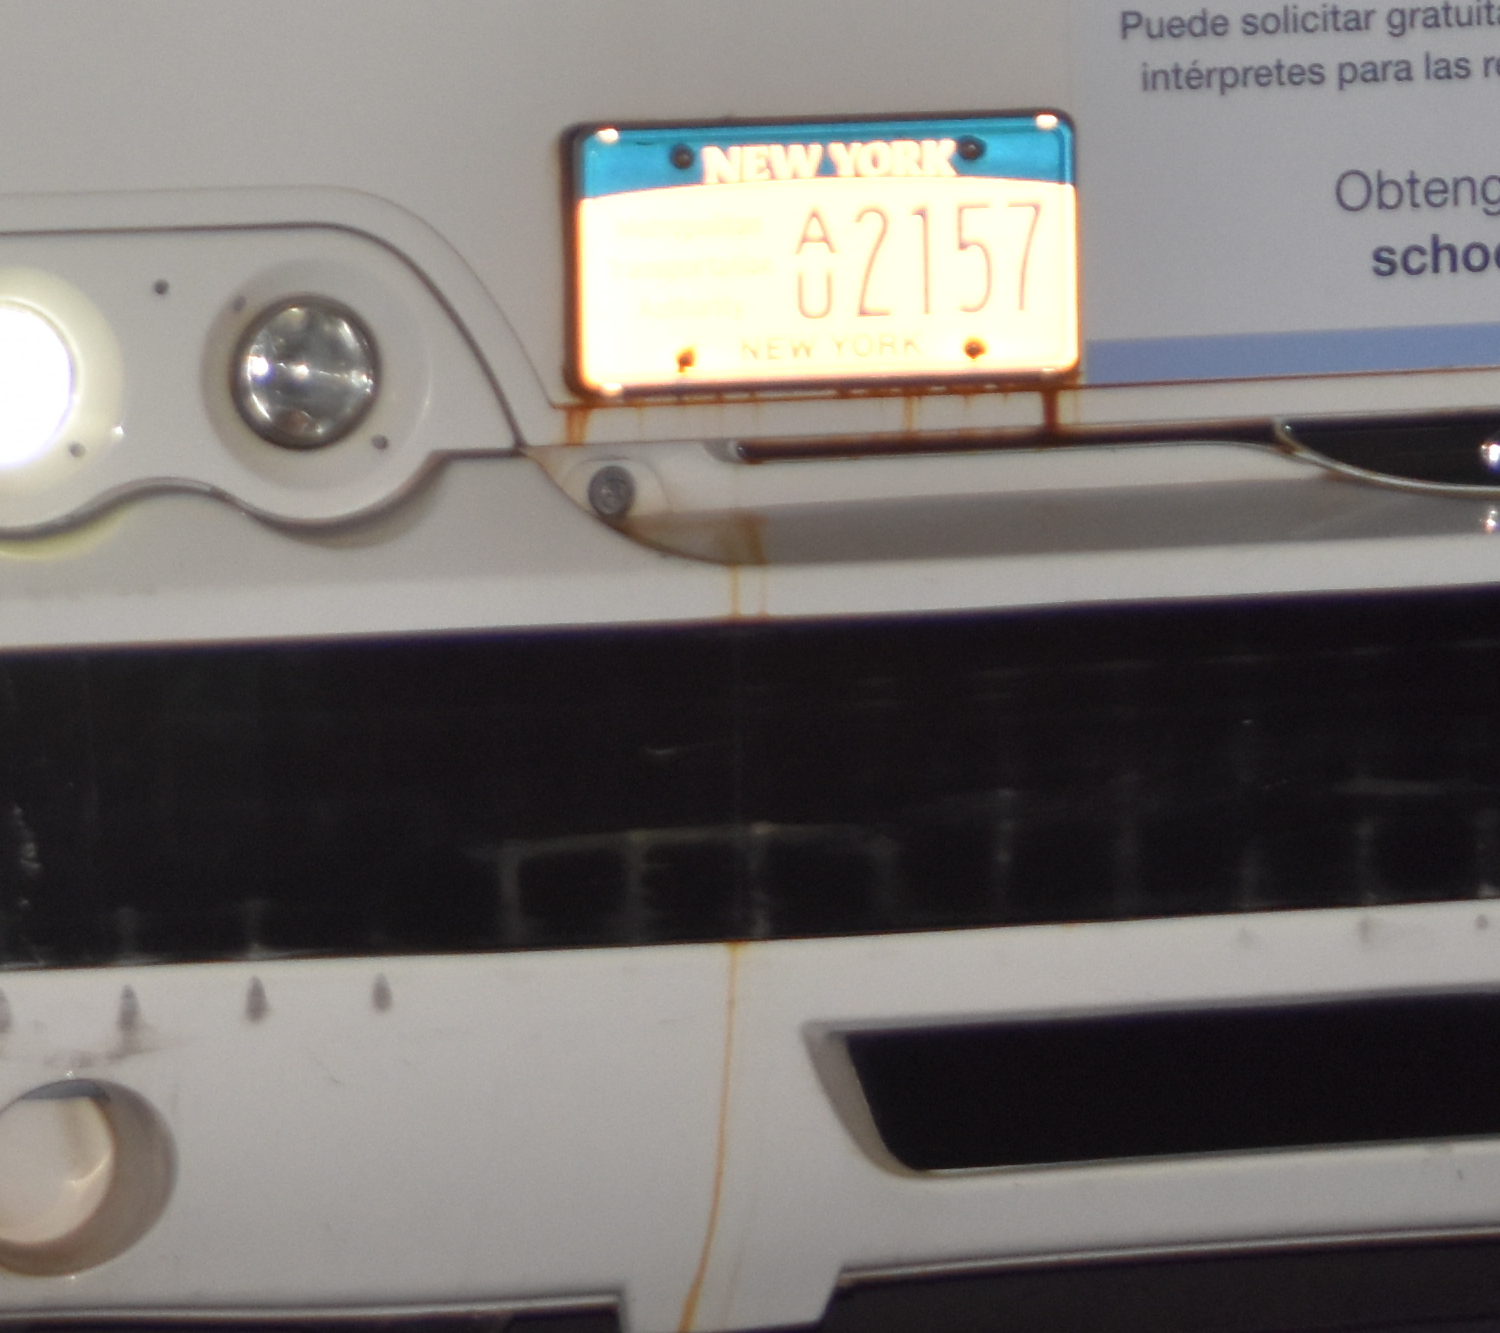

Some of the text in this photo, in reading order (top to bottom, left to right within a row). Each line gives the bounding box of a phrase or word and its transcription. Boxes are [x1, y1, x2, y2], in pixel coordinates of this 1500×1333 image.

[1121, 8, 1228, 40] Puede
[1241, 3, 1375, 36] solicitar
[1141, 58, 1325, 95] intérpretes
[1337, 58, 1413, 90] para
[1425, 51, 1471, 81] las
[703, 139, 961, 184] NEW YORK
[855, 202, 1043, 318] 2157
[741, 334, 923, 361] NEW YORK
